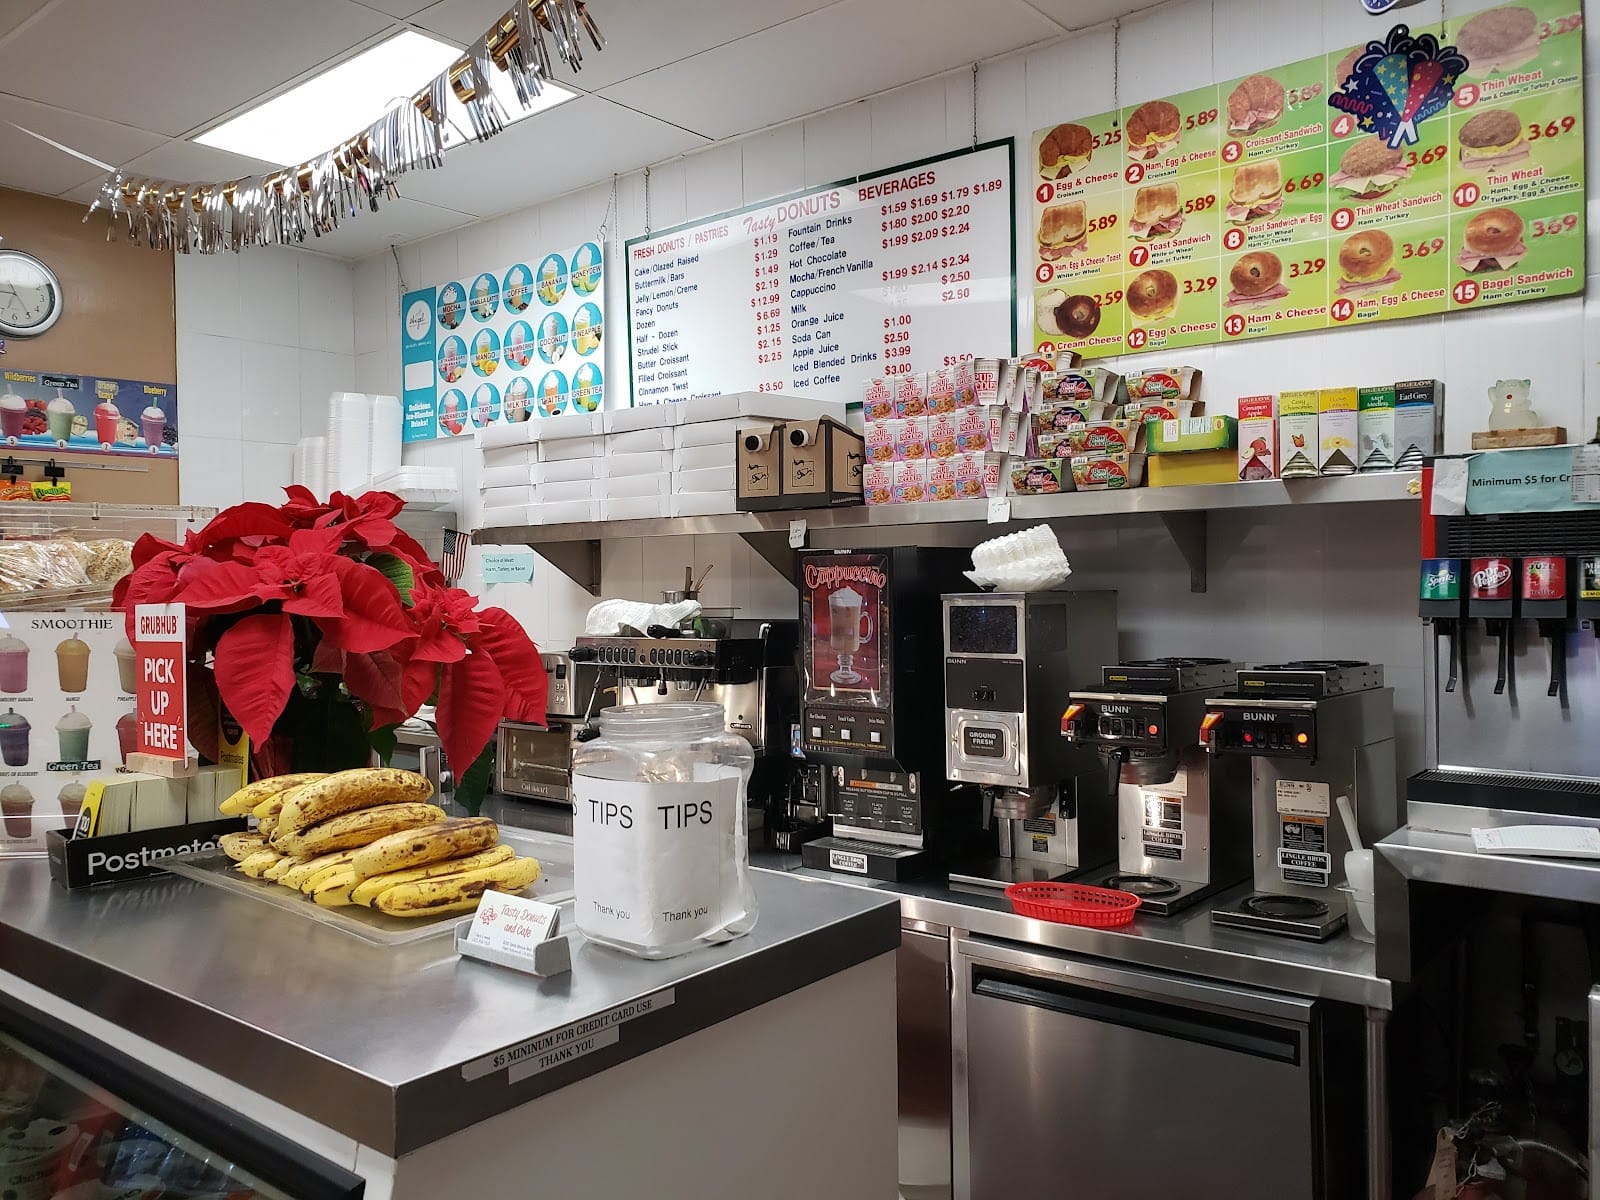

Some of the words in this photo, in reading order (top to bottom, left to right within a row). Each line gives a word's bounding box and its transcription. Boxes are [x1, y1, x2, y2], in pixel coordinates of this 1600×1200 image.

[1482, 81, 1504, 92] Thin
[1508, 71, 1542, 85] Wheat
[1186, 108, 1218, 129] 5.89
[1246, 131, 1282, 148] Croissant
[1284, 124, 1322, 140] Sandwich
[1528, 116, 1575, 141] 3.69
[1092, 130, 1122, 150] 5.25
[1407, 145, 1448, 168] 3.69
[1056, 178, 1073, 191] Egg
[1076, 177, 1083, 187] &
[1086, 171, 1118, 184] Cheese
[1129, 166, 1141, 182] 2
[1284, 172, 1324, 193] 6.69
[1488, 175, 1508, 185] Thin
[1512, 167, 1543, 181] Wheat
[858, 171, 936, 201] BEVERAGES
[1040, 186, 1049, 200] 1
[881, 202, 907, 216] $1.59
[911, 195, 938, 210] $1.69
[941, 187, 970, 202] $1.79
[973, 179, 1002, 196] $1.89
[1456, 187, 1476, 204] 10
[743, 214, 777, 235] Tasty
[777, 191, 841, 224] DONUTS
[1185, 195, 1216, 214] 5.89
[788, 223, 822, 238] Fountain
[826, 215, 852, 229] Drinks
[882, 218, 908, 233] $1.80
[911, 211, 938, 226] $2.00
[941, 204, 970, 219] $2.20
[1089, 214, 1118, 233] 5.89
[634, 248, 655, 260] FRESH
[657, 237, 685, 254] DONUTS
[695, 226, 729, 244] PASTRIES
[754, 234, 778, 247] $1.19
[1150, 238, 1170, 252] Toast
[1173, 233, 1211, 248] Sandwich
[1402, 238, 1444, 259] 3.69
[754, 249, 778, 262] $1.29
[789, 258, 803, 270] Hot
[807, 250, 847, 265] Chocolate
[572, 266, 601, 279] HONEYDEW
[755, 264, 779, 277] $1.49
[882, 268, 908, 282] $1.99
[911, 262, 938, 276] $2.14
[942, 254, 970, 269] $2.34
[1290, 259, 1326, 278] 3.29
[541, 277, 562, 288] BANANA
[1184, 277, 1217, 294] 3.29
[1482, 277, 1513, 291] Bagel
[1517, 268, 1573, 285] Sandwich
[507, 287, 528, 297] COFFEE
[790, 282, 836, 300] Cappuccino
[1094, 290, 1123, 308] 2.59
[1454, 283, 1476, 300] 15
[443, 305, 461, 313] MOCHA
[636, 306, 653, 317] Fancy
[657, 301, 679, 313] Donuts
[751, 294, 780, 308] $12.99
[791, 305, 806, 315] Milk
[1248, 313, 1271, 324] Ham
[1275, 311, 1283, 320] &
[1287, 305, 1327, 318] Cheese
[1333, 302, 1351, 318] 14
[636, 320, 655, 330] Dozen
[791, 316, 819, 329] Orange
[824, 311, 845, 324] Juice
[884, 315, 912, 328] $1.00
[1225, 318, 1244, 334] 13
[573, 326, 601, 337] PINEAPPLE
[757, 324, 781, 336] $1.25
[792, 333, 812, 345] Soda
[815, 330, 831, 340] Can
[1128, 331, 1145, 346] 12
[540, 335, 566, 347] COCONUT
[637, 345, 660, 357] Strudel
[663, 342, 678, 353] Stick
[1057, 340, 1087, 350] Cream
[1089, 336, 1122, 347] Cheese
[476, 352, 495, 360] MANGO
[884, 345, 911, 359] $3.99
[638, 359, 657, 370] Butter
[659, 354, 690, 366] Croissant
[792, 362, 809, 373] Iced
[813, 356, 845, 369] Blended
[851, 352, 877, 364] Drinks
[884, 363, 912, 376] $3.00
[793, 378, 809, 389] Iced
[813, 374, 841, 386] Coffee
[1396, 380, 1433, 388] BIGELOW
[572, 389, 590, 398] GREEN
[591, 386, 602, 394] TEA
[1413, 392, 1428, 400] Grey
[1472, 477, 1522, 487] Minimum
[1524, 475, 1538, 485] $5
[1541, 474, 1556, 483] for
[806, 564, 886, 589] Cappuccino
[1477, 569, 1508, 588] Pepper
[1485, 567, 1498, 576] Dr
[1429, 573, 1455, 588] Sprite
[31, 620, 113, 629] SMOOTHIE
[140, 615, 177, 635] GRUBHUB
[144, 657, 175, 684] PICK
[151, 691, 169, 716] UP
[1101, 705, 1129, 714] BUNN
[1243, 712, 1275, 721] BUNN
[143, 722, 178, 750] HERE
[968, 731, 997, 740] GROUND
[972, 738, 994, 746] FRESH
[48, 762, 78, 771] Green
[81, 762, 98, 770] Tea
[588, 798, 633, 829] TIPS
[657, 799, 714, 830] TIPS
[1281, 852, 1307, 860] LINGLE
[1291, 859, 1317, 867] COFFEE
[501, 904, 520, 921] Tasty
[520, 909, 547, 926] Donuts
[593, 901, 614, 917] Thank
[616, 907, 631, 920] you
[662, 909, 692, 923] Thank
[694, 905, 708, 919] you
[504, 924, 515, 933] and
[516, 925, 532, 939] Cafe
[493, 1054, 505, 1067] $5
[508, 1035, 554, 1063] MININUM
[555, 1029, 574, 1044] FOR
[576, 1017, 610, 1038] CREDIT
[611, 1006, 635, 1022] CARD
[637, 999, 653, 1014] USE
[538, 1047, 573, 1068] THANK
[575, 1037, 595, 1054] YOU
